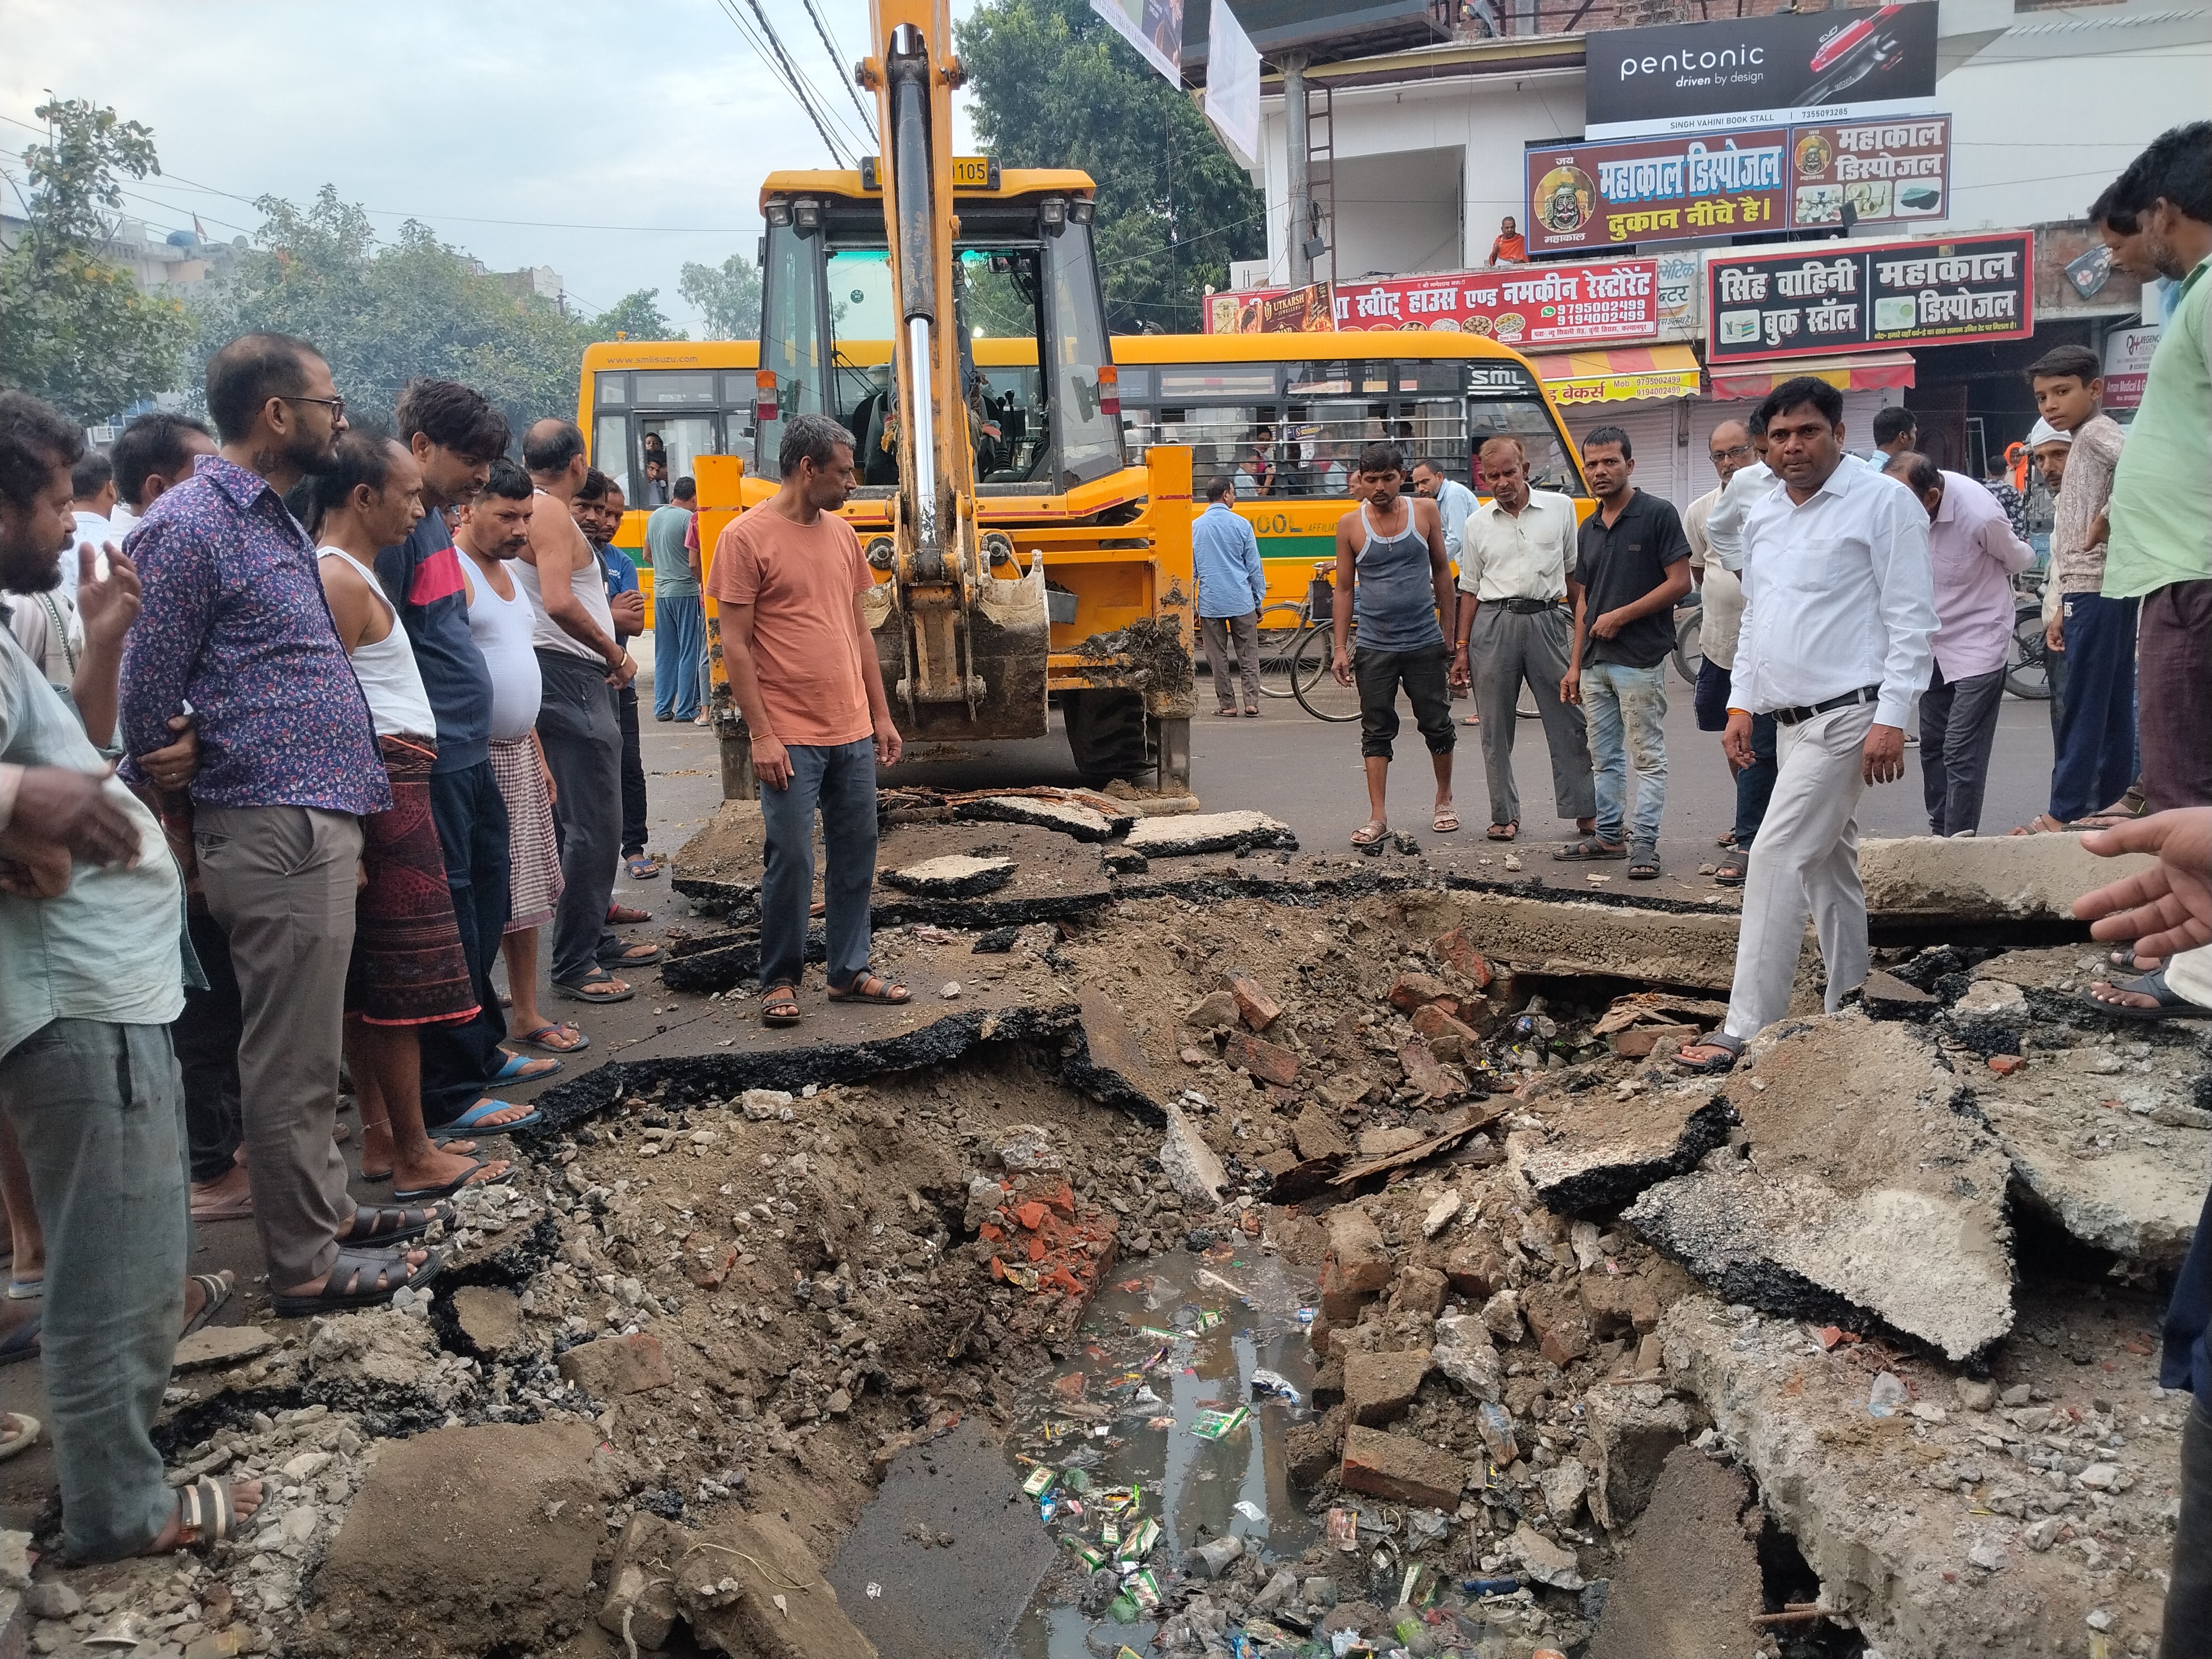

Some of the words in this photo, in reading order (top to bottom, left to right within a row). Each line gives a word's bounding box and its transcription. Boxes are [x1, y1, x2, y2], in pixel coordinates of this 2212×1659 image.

[1819, 25, 1838, 43] EVO
[1621, 44, 1764, 81] pentonic
[1676, 75, 1711, 88] driven
[1715, 73, 1727, 86] by
[1731, 71, 1764, 84] design
[1670, 120, 1695, 129] SINGH
[1697, 118, 1724, 127] VAHINI
[1726, 116, 1748, 125] BOOK
[1750, 114, 1774, 123] STALL
[1802, 108, 1848, 119] 7355093285
[1836, 122, 1946, 150] महाकाल
[1555, 156, 1574, 166] जय
[1598, 154, 1684, 199] महाकाल
[1688, 139, 1783, 193] डिस्पोजल
[1835, 153, 1944, 181] डिस्पोजल
[1607, 209, 1679, 241] दुकान
[1684, 201, 1734, 226] नीचे
[1741, 197, 1771, 221] है।
[1545, 233, 1585, 243] महाकाल
[1876, 252, 2017, 287] महाकाल
[1720, 266, 1768, 301] सिंह
[1776, 259, 1857, 297] वाहिनी
[1407, 287, 1458, 313] हाउस
[1464, 288, 1499, 308] एण्ड
[1502, 272, 1579, 305] नमकीन
[1582, 266, 1652, 299] रेस्टोरेंट
[1273, 294, 1304, 311] UTKARSH
[1278, 305, 1301, 316] JEWELLERS
[1558, 299, 1645, 315] 9795002499
[1918, 287, 2016, 324] डिस्पोजल
[1557, 310, 1645, 325] 9194002499
[1763, 308, 1800, 345] बुक
[1806, 298, 1857, 331] स्टॉल
[607, 356, 698, 364] www.smlisuzu.com
[1637, 376, 1681, 386] 9795002499
[2119, 380, 2137, 392] Medical
[1562, 382, 1605, 400] बेकर्स
[1637, 387, 1681, 396] 9194002499
[1249, 514, 1303, 533] OOL
